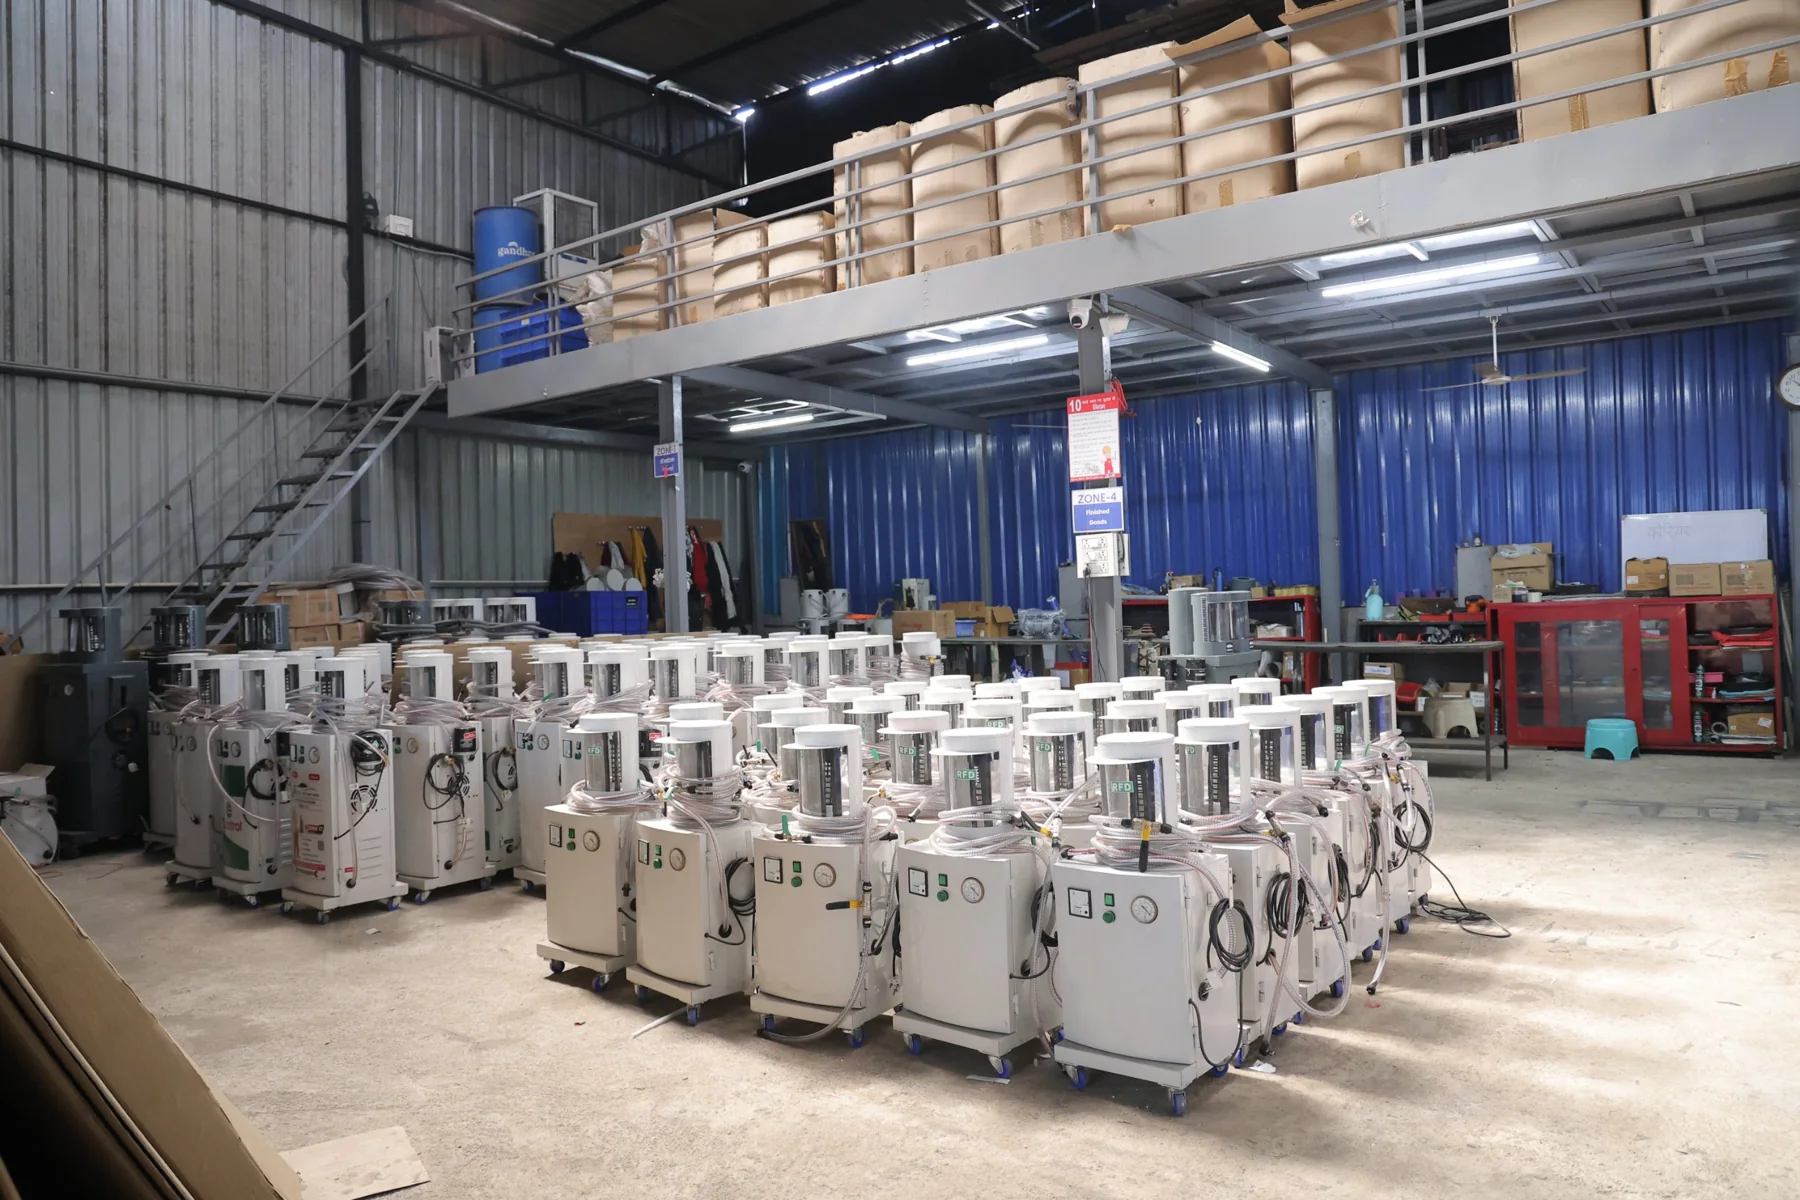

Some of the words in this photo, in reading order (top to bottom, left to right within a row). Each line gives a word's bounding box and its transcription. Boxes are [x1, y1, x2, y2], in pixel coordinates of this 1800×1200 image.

[1069, 399, 1082, 412] 10
[1077, 492, 1117, 504] ZONE-4
[1085, 508, 1110, 516] Finished
[899, 747, 914, 755] RFD
[957, 770, 975, 779] RFD
[1112, 782, 1132, 791] RFD
